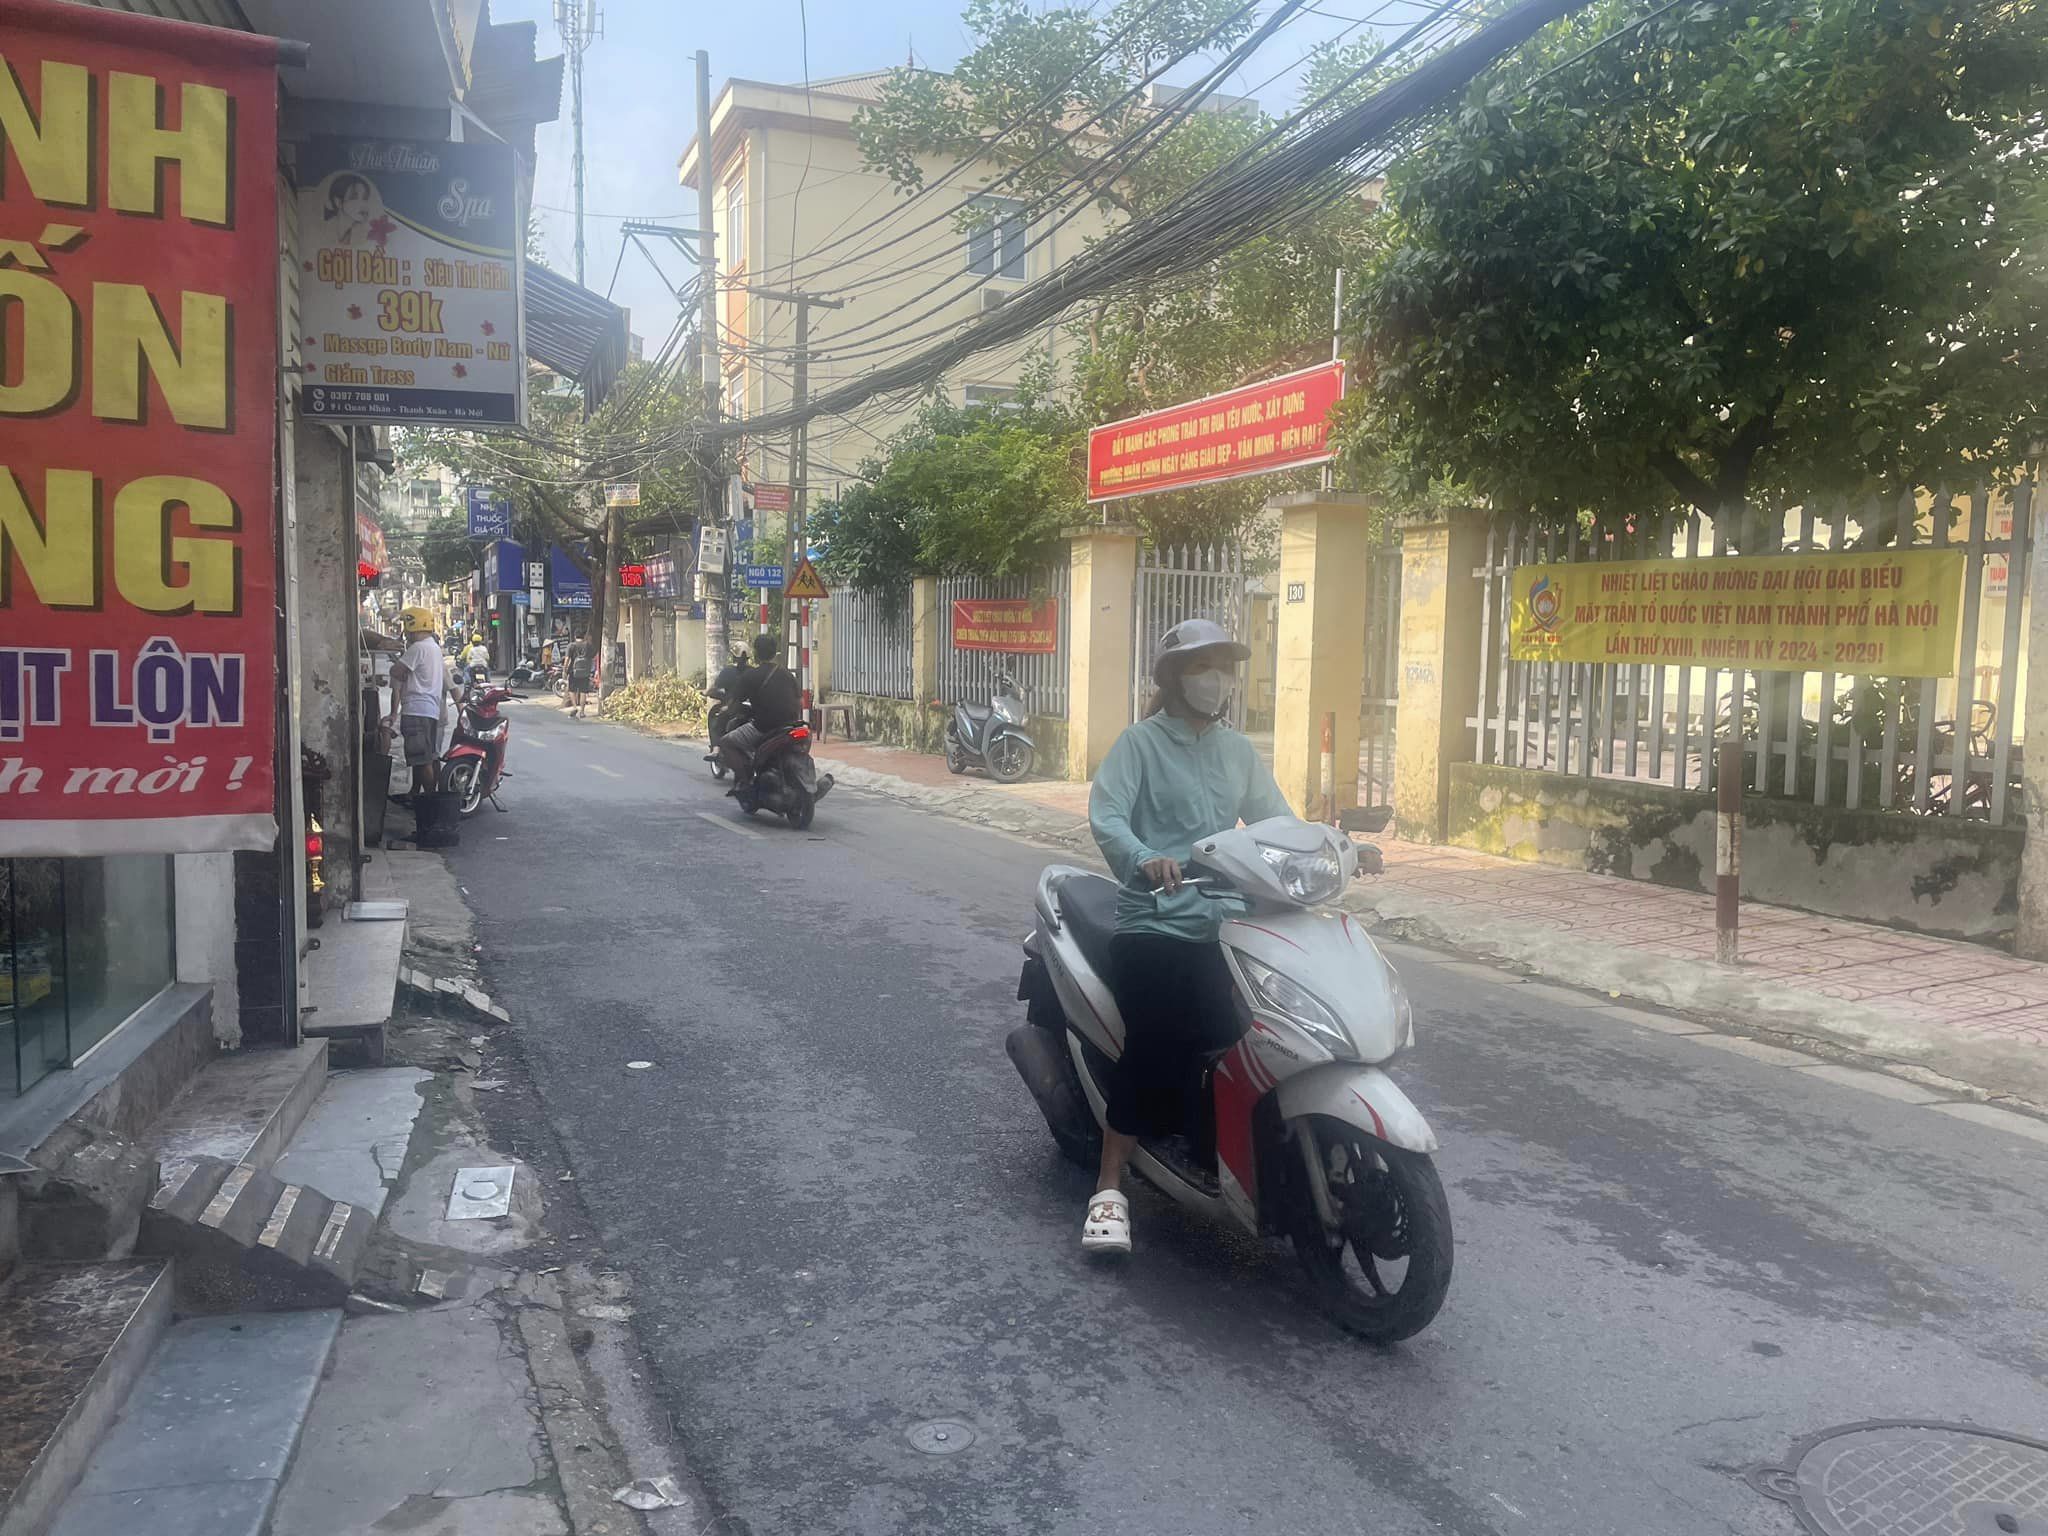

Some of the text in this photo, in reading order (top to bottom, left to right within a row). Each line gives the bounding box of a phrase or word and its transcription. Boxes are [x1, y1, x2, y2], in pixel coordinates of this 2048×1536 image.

[437, 178, 496, 227] Spa
[318, 248, 353, 290] Gội
[357, 246, 399, 286] Đầu
[377, 289, 444, 334] 39k
[323, 333, 388, 356] Massge
[391, 336, 431, 359] Body
[435, 338, 472, 359] Nam
[370, 365, 415, 385] Tress
[400, 405, 424, 414] Thanh
[1144, 427, 1157, 449] CÁC
[0, 464, 238, 615] NG
[768, 567, 781, 577] 132
[1601, 558, 1904, 595] NHIỆT LIỆT CHÀO MỪNG ĐẠI HỘI ĐẠI BIỂU
[1288, 585, 1303, 600] 130
[1604, 603, 1638, 628] TRẬN
[1641, 594, 1657, 624] TỔ
[1660, 597, 1697, 626] QUỐC
[1702, 602, 1731, 628] VIỆT
[1735, 604, 1772, 625] NAM
[1777, 601, 1830, 626] THÀNH
[1834, 597, 1872, 627] PHỐ
[1875, 602, 1900, 627] HÀ
[1905, 600, 1939, 632] NỘI
[1634, 633, 1661, 656] THỨ
[1662, 636, 1697, 659] XVIII,
[1754, 636, 1774, 659] KỲ
[1778, 640, 1817, 662] 2024
[1835, 642, 1884, 664] 2029!
[90, 636, 245, 743] LỘN
[63, 755, 208, 794] mời
[226, 756, 254, 791] !
[1266, 1038, 1299, 1061] HONDA
